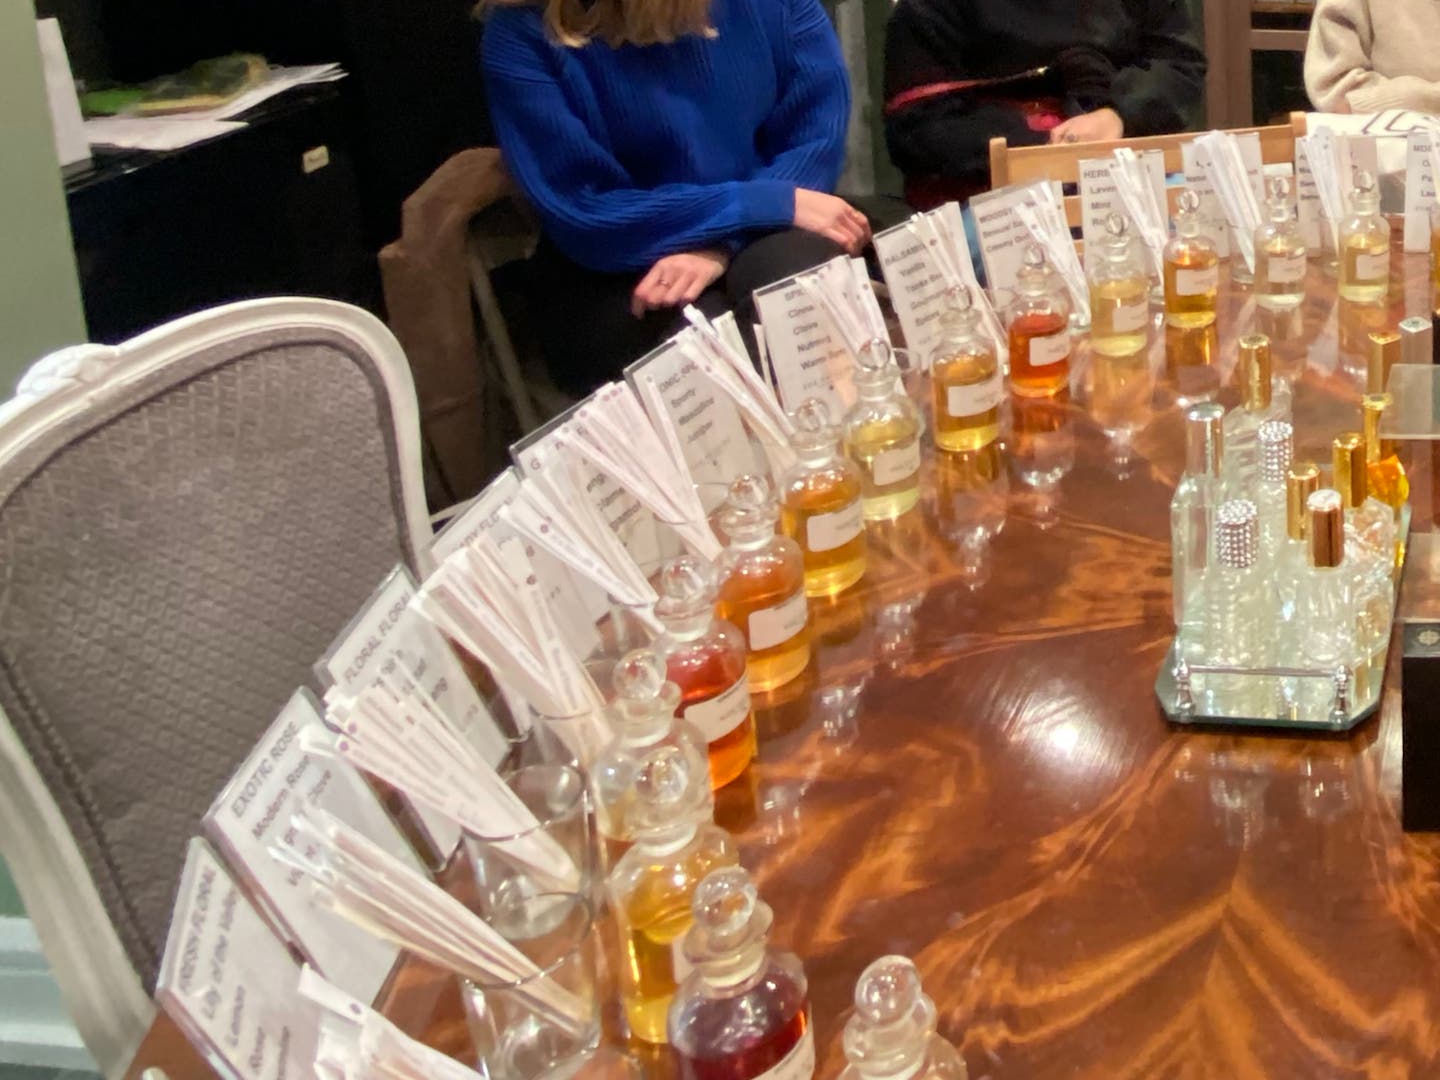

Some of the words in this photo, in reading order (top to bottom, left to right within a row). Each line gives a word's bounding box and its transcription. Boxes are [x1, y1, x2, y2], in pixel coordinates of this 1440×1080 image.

[1089, 185, 1117, 195] Laven
[792, 322, 819, 336] Clove
[343, 635, 383, 684] FLORAL
[231, 758, 274, 819] EXOTIC
[269, 720, 300, 760] ROSE
[252, 787, 290, 841] Modern
[286, 754, 311, 789] Rose
